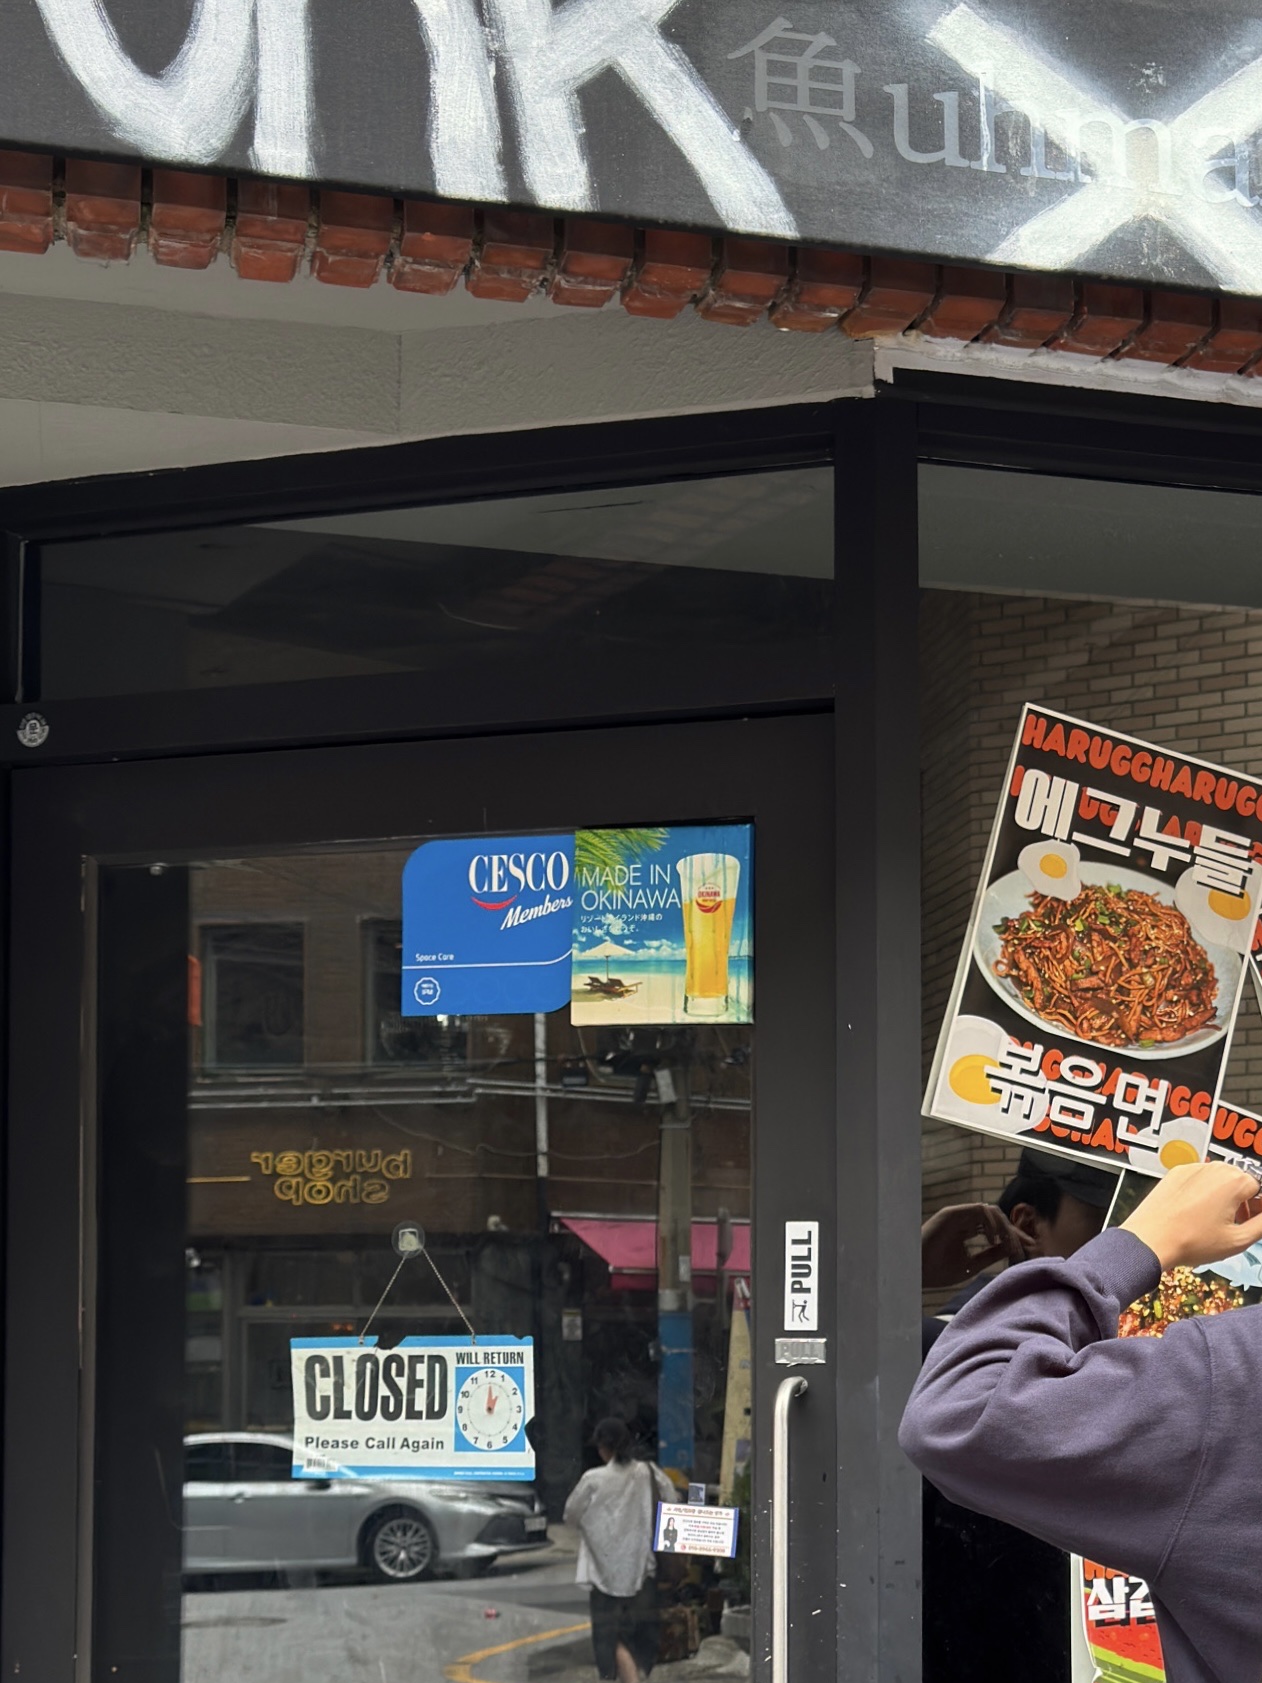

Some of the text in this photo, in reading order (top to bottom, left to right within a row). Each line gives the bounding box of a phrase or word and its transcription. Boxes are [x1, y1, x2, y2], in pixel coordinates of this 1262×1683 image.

[727, 15, 874, 158] 魚
[1014, 768, 1253, 896] 에그누들
[468, 851, 570, 894] CESCO
[582, 864, 671, 887] MADE IN
[581, 887, 682, 911] OKINAWA
[499, 893, 574, 930] Members
[580, 913, 663, 923] リゾートイランド沖縄の
[415, 952, 455, 962] Space Care
[984, 1033, 1169, 1148] 볶음면
[791, 1230, 812, 1294] PULL
[456, 1352, 524, 1365] WILL RETURN
[485, 1370, 496, 1378] 12
[501, 1374, 505, 1382] 1
[470, 1376, 479, 1385] 11
[304, 1353, 448, 1422] CLOSED
[512, 1387, 518, 1395] 2
[460, 1390, 470, 1399] 10
[457, 1405, 463, 1414] 9
[516, 1405, 522, 1414] 3
[462, 1423, 468, 1432] 8
[512, 1423, 518, 1431] 4
[304, 1436, 444, 1453] Please Call Again
[473, 1437, 479, 1445] 7
[486, 1440, 493, 1449] 6
[502, 1436, 508, 1444] 5
